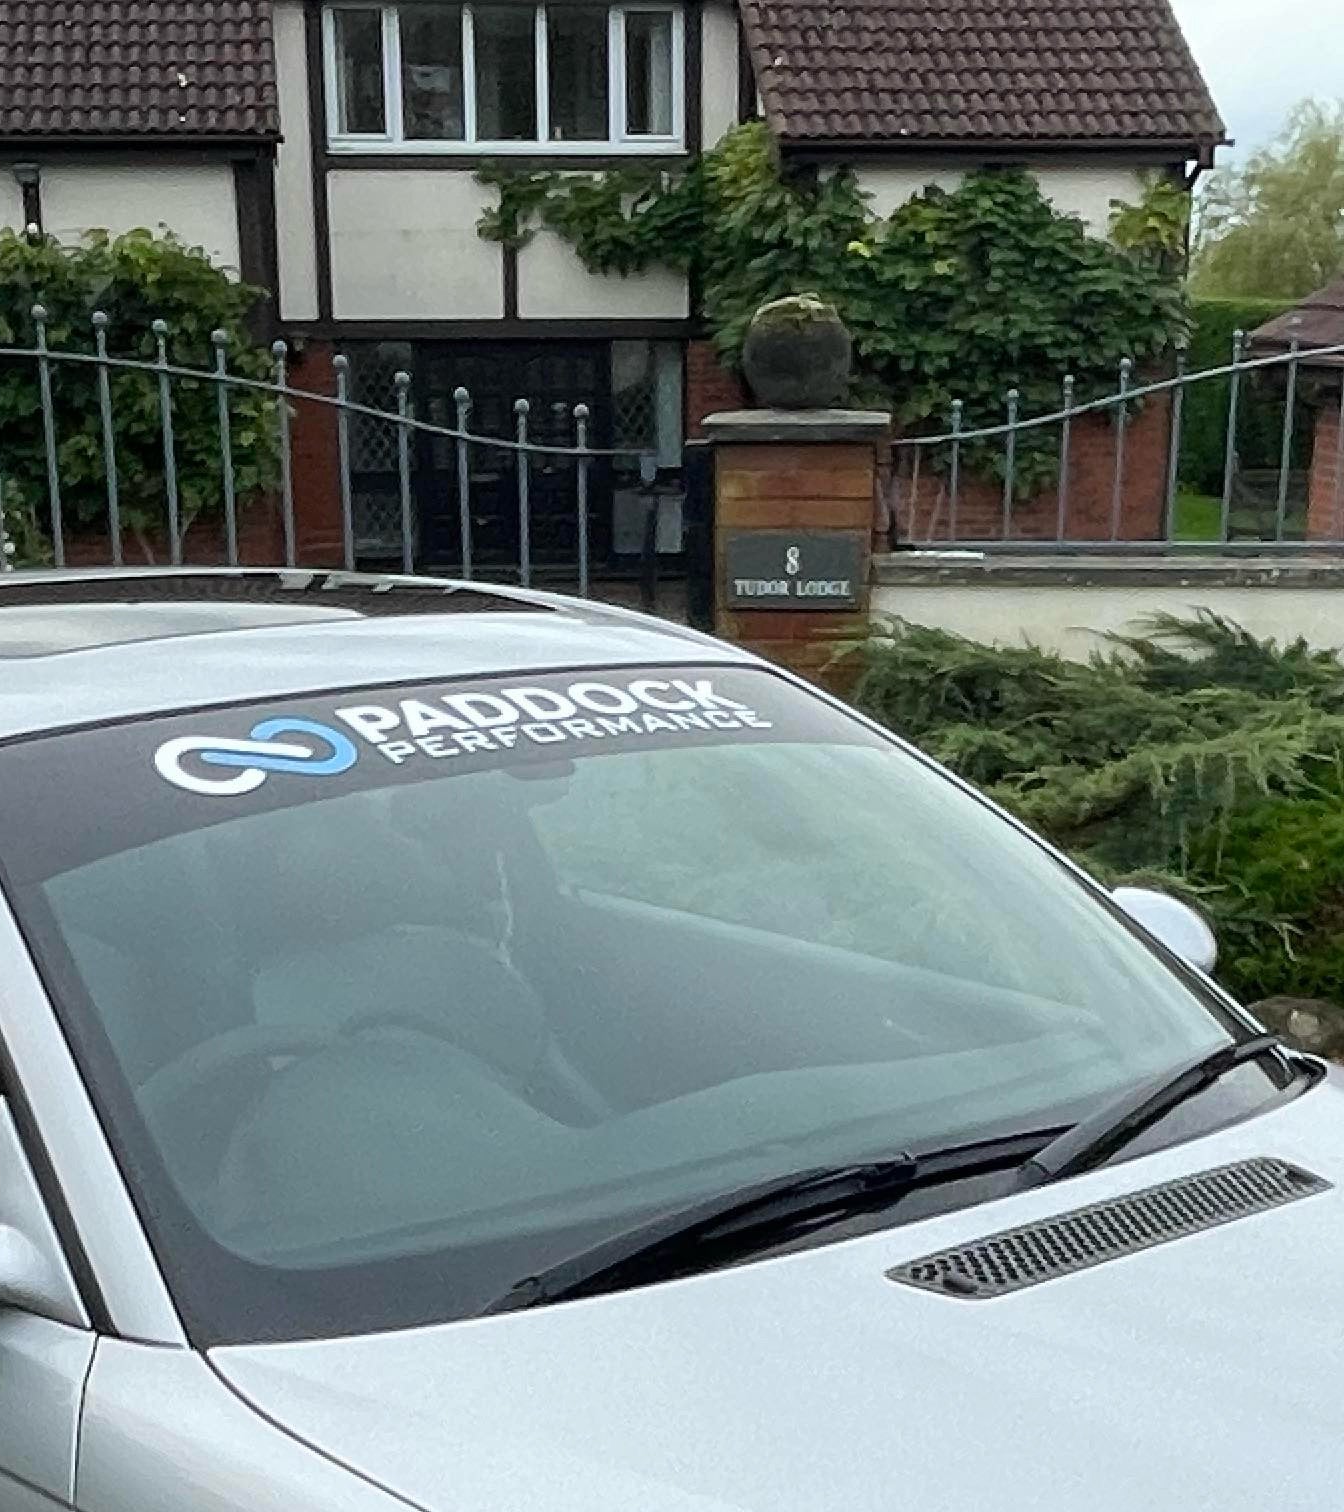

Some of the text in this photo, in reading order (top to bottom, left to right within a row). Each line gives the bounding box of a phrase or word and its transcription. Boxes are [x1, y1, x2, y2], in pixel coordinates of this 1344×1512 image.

[785, 546, 800, 575] 8
[734, 578, 851, 596] TUDOR LODGE
[335, 679, 749, 744] PADDOCK
[377, 710, 772, 764] PERFORMANCE
